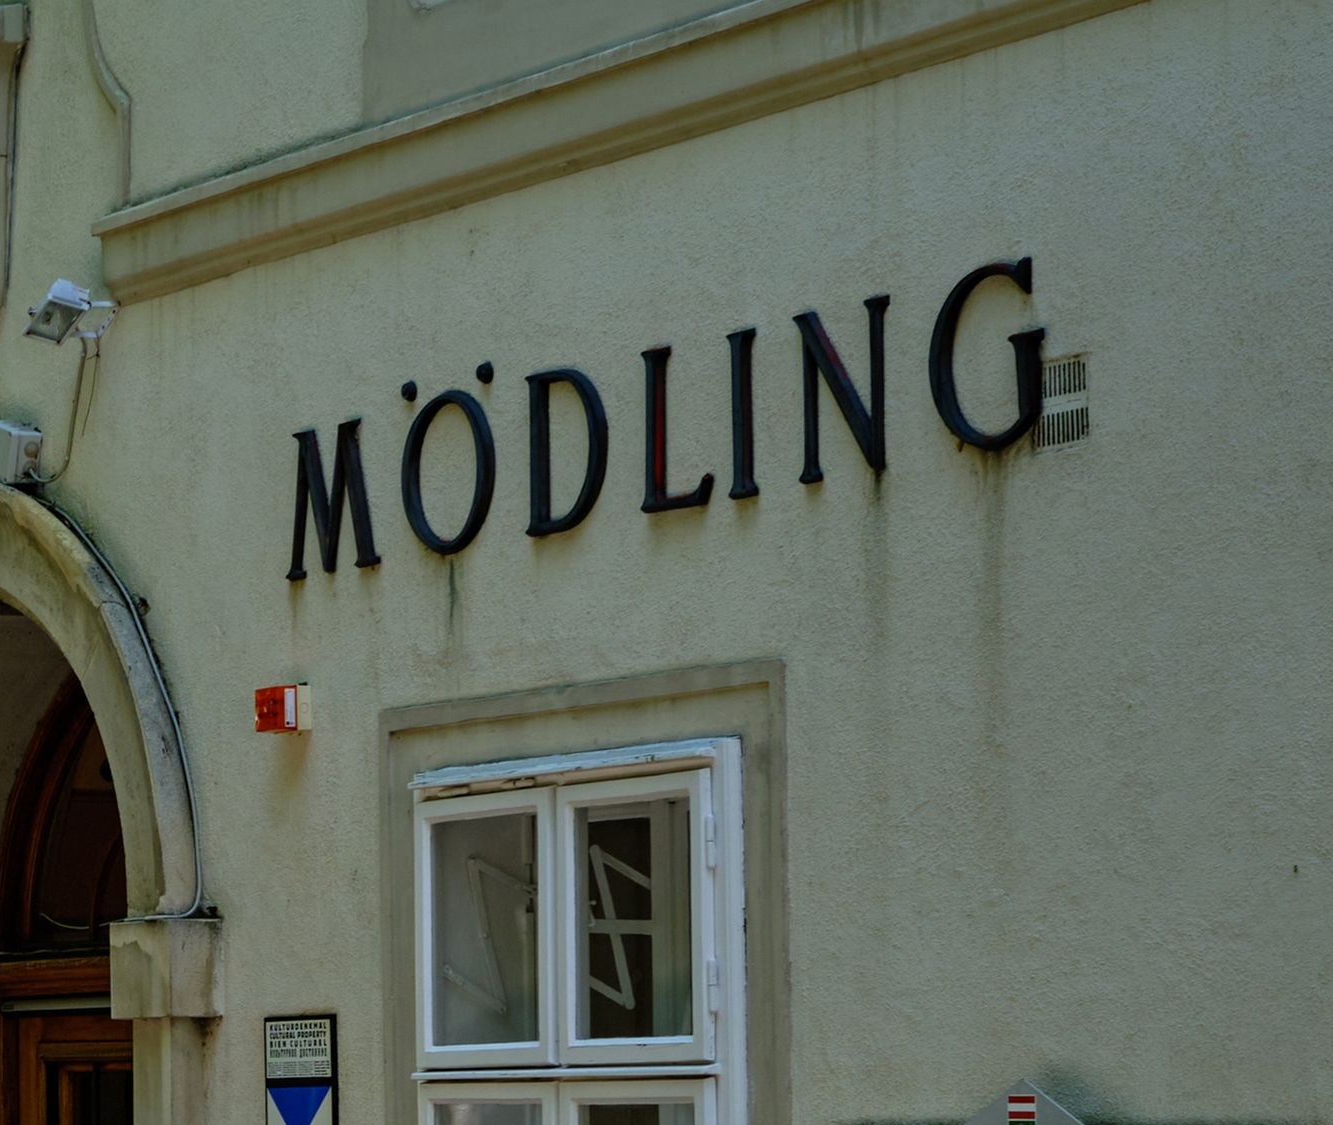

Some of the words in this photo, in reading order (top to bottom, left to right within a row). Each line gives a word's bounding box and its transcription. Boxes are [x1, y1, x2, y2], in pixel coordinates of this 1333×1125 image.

[286, 256, 1046, 582] MÖDLING
[269, 1022, 327, 1031] KULTURDENKMAL
[269, 1032, 295, 1040] CULTURAL
[269, 1040, 286, 1048] BIEN
[290, 1039, 327, 1047] CULTUREL
